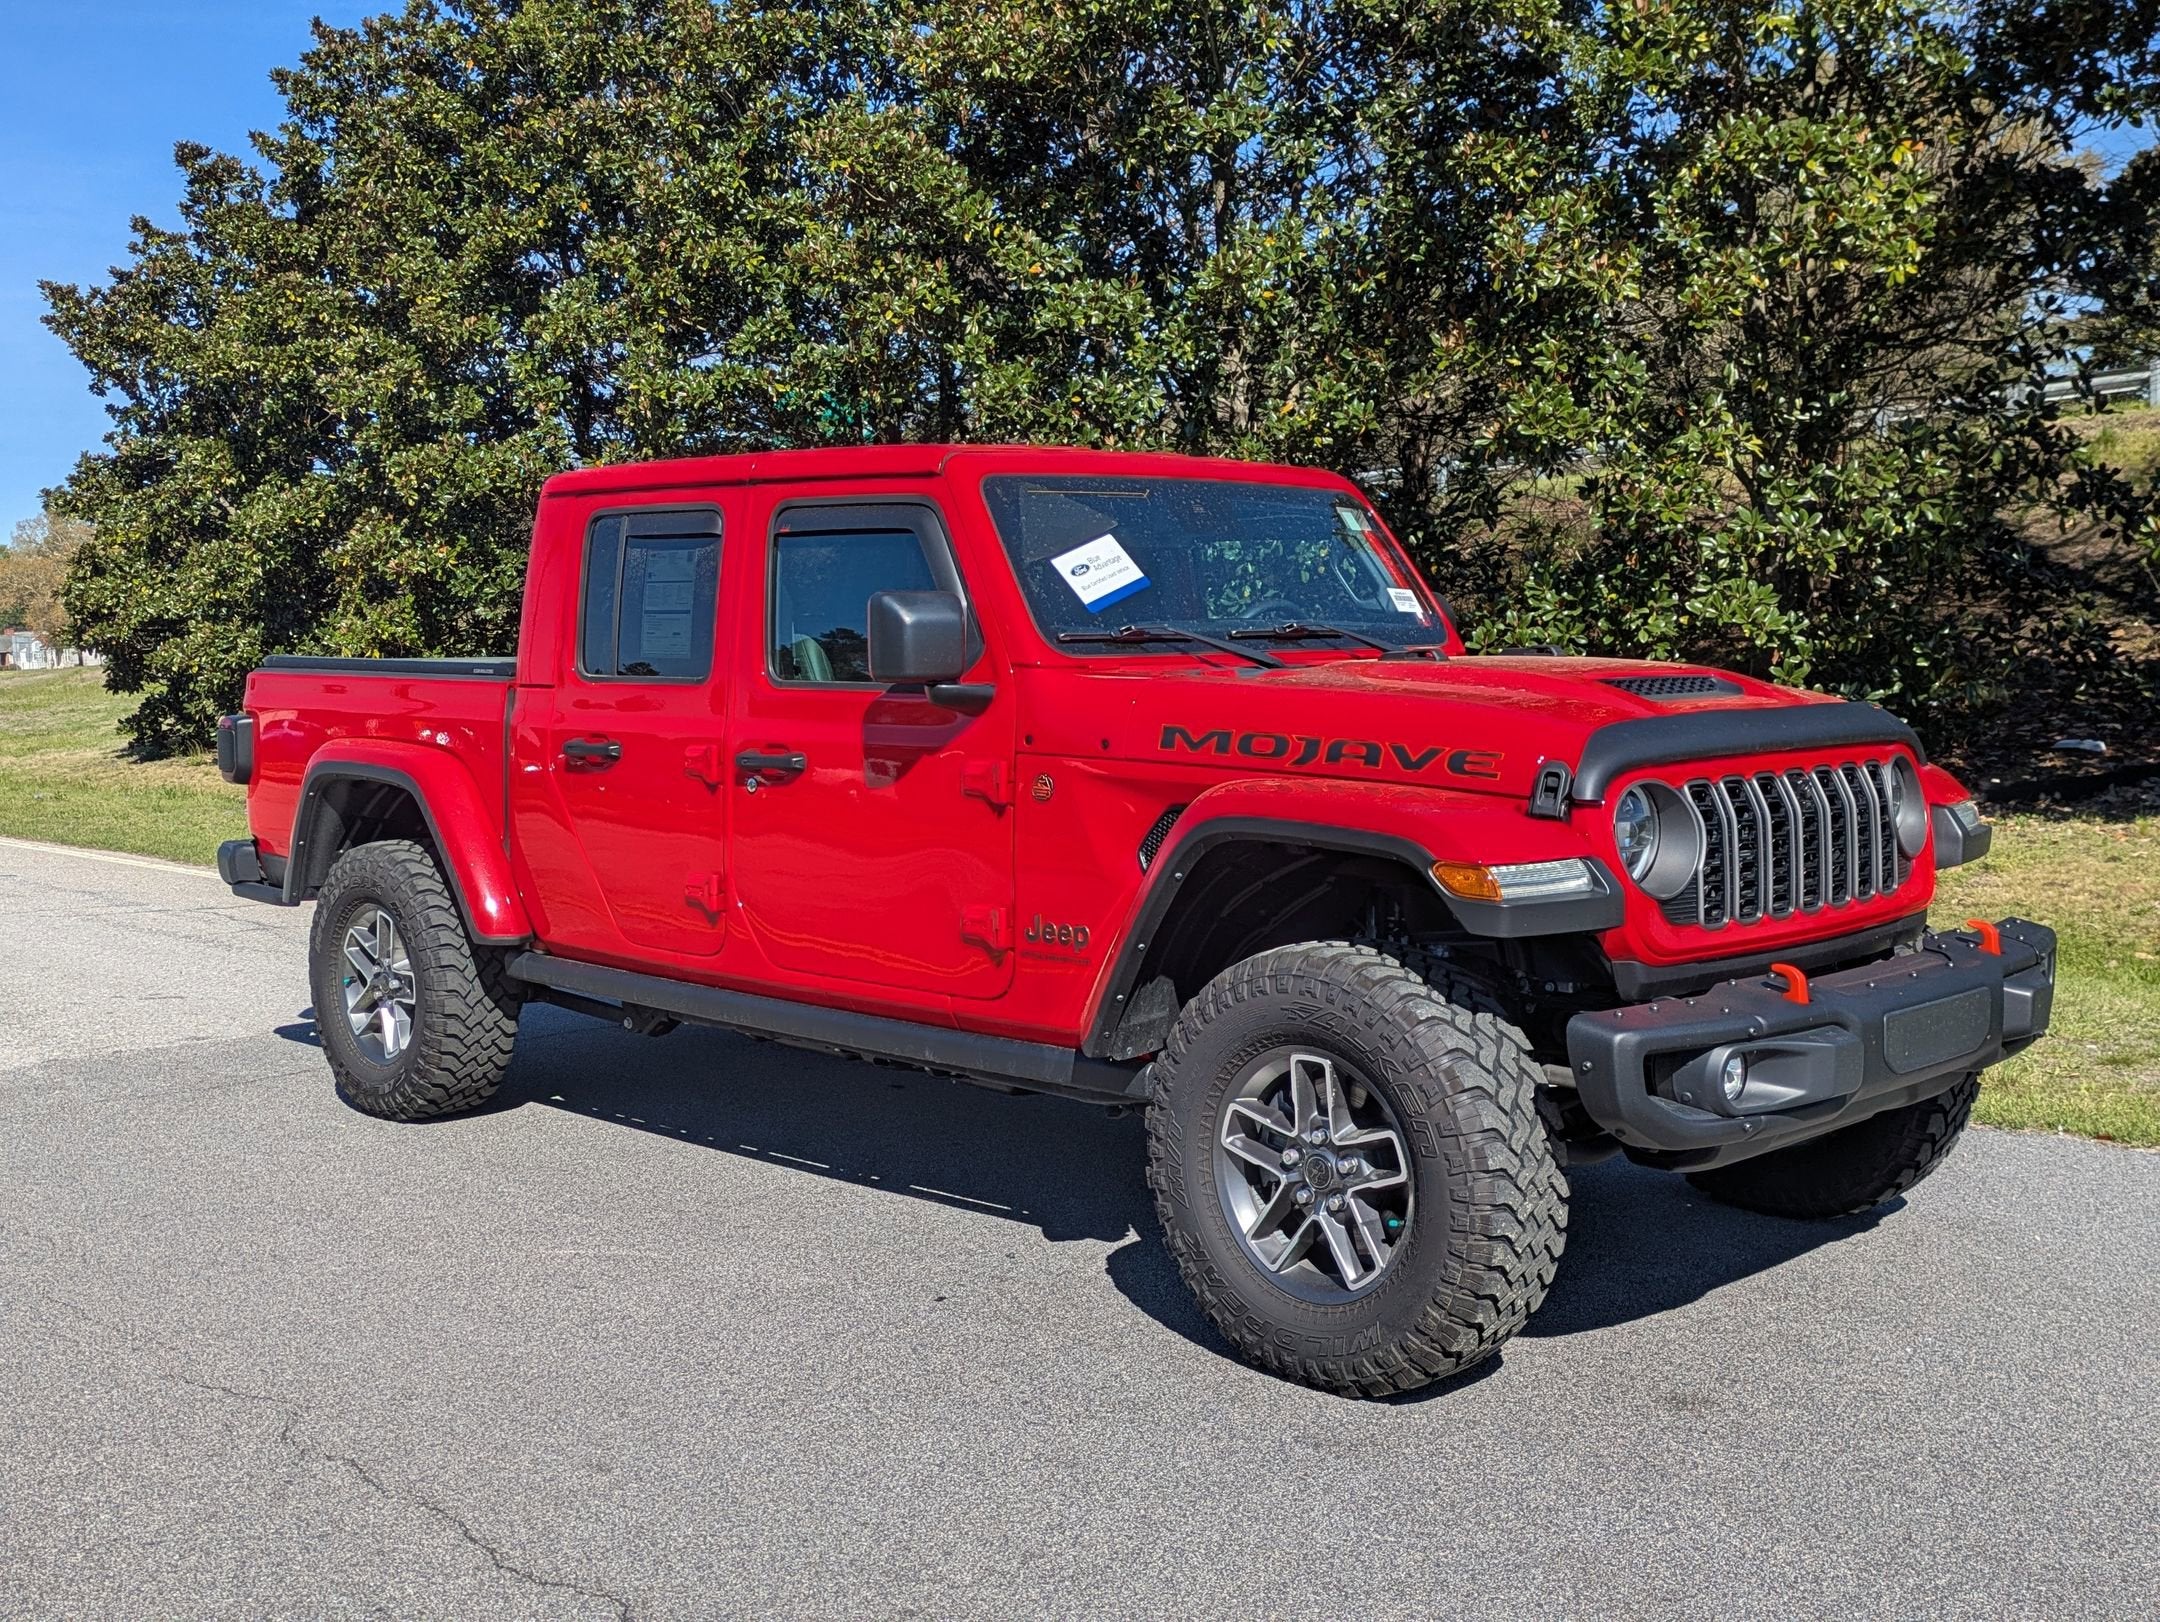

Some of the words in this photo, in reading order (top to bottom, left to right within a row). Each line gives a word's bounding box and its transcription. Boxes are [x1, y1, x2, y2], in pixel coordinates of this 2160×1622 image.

[1086, 555, 1100, 565] Blue
[1093, 554, 1122, 571] Advantage
[1158, 723, 1505, 780] MOJAVE
[1024, 912, 1090, 953] Jeep
[1281, 1001, 1439, 1158] FALKEN
[1182, 1231, 1381, 1358] WILDPEAK
